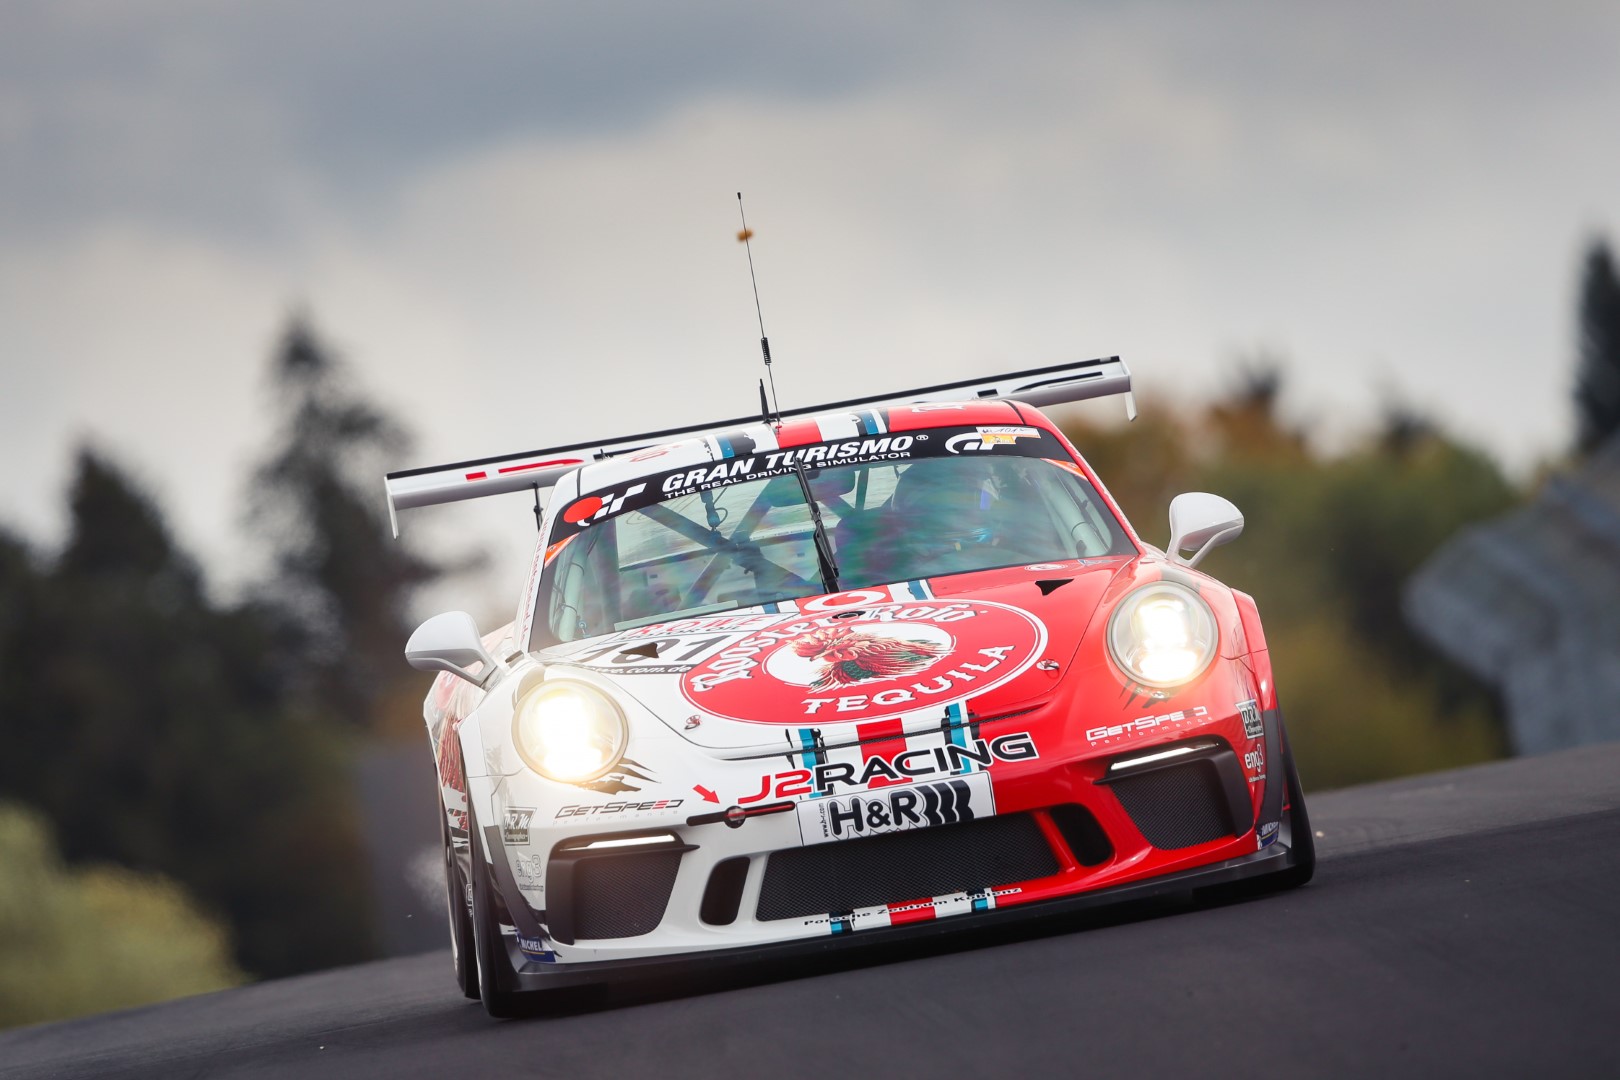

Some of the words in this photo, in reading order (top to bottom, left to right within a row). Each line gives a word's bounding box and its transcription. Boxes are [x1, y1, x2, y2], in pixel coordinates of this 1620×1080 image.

[661, 458, 756, 493] GRAN
[664, 488, 697, 500] THE
[701, 477, 743, 491] REAL
[746, 461, 812, 481] DRIVING
[816, 451, 912, 468] SIMULATOR
[801, 645, 1016, 715] TEQUILA
[829, 788, 922, 836] H&R
[804, 908, 871, 926] Porsche
[877, 899, 948, 915] Zentrum
[954, 887, 1022, 903] Koblenz
